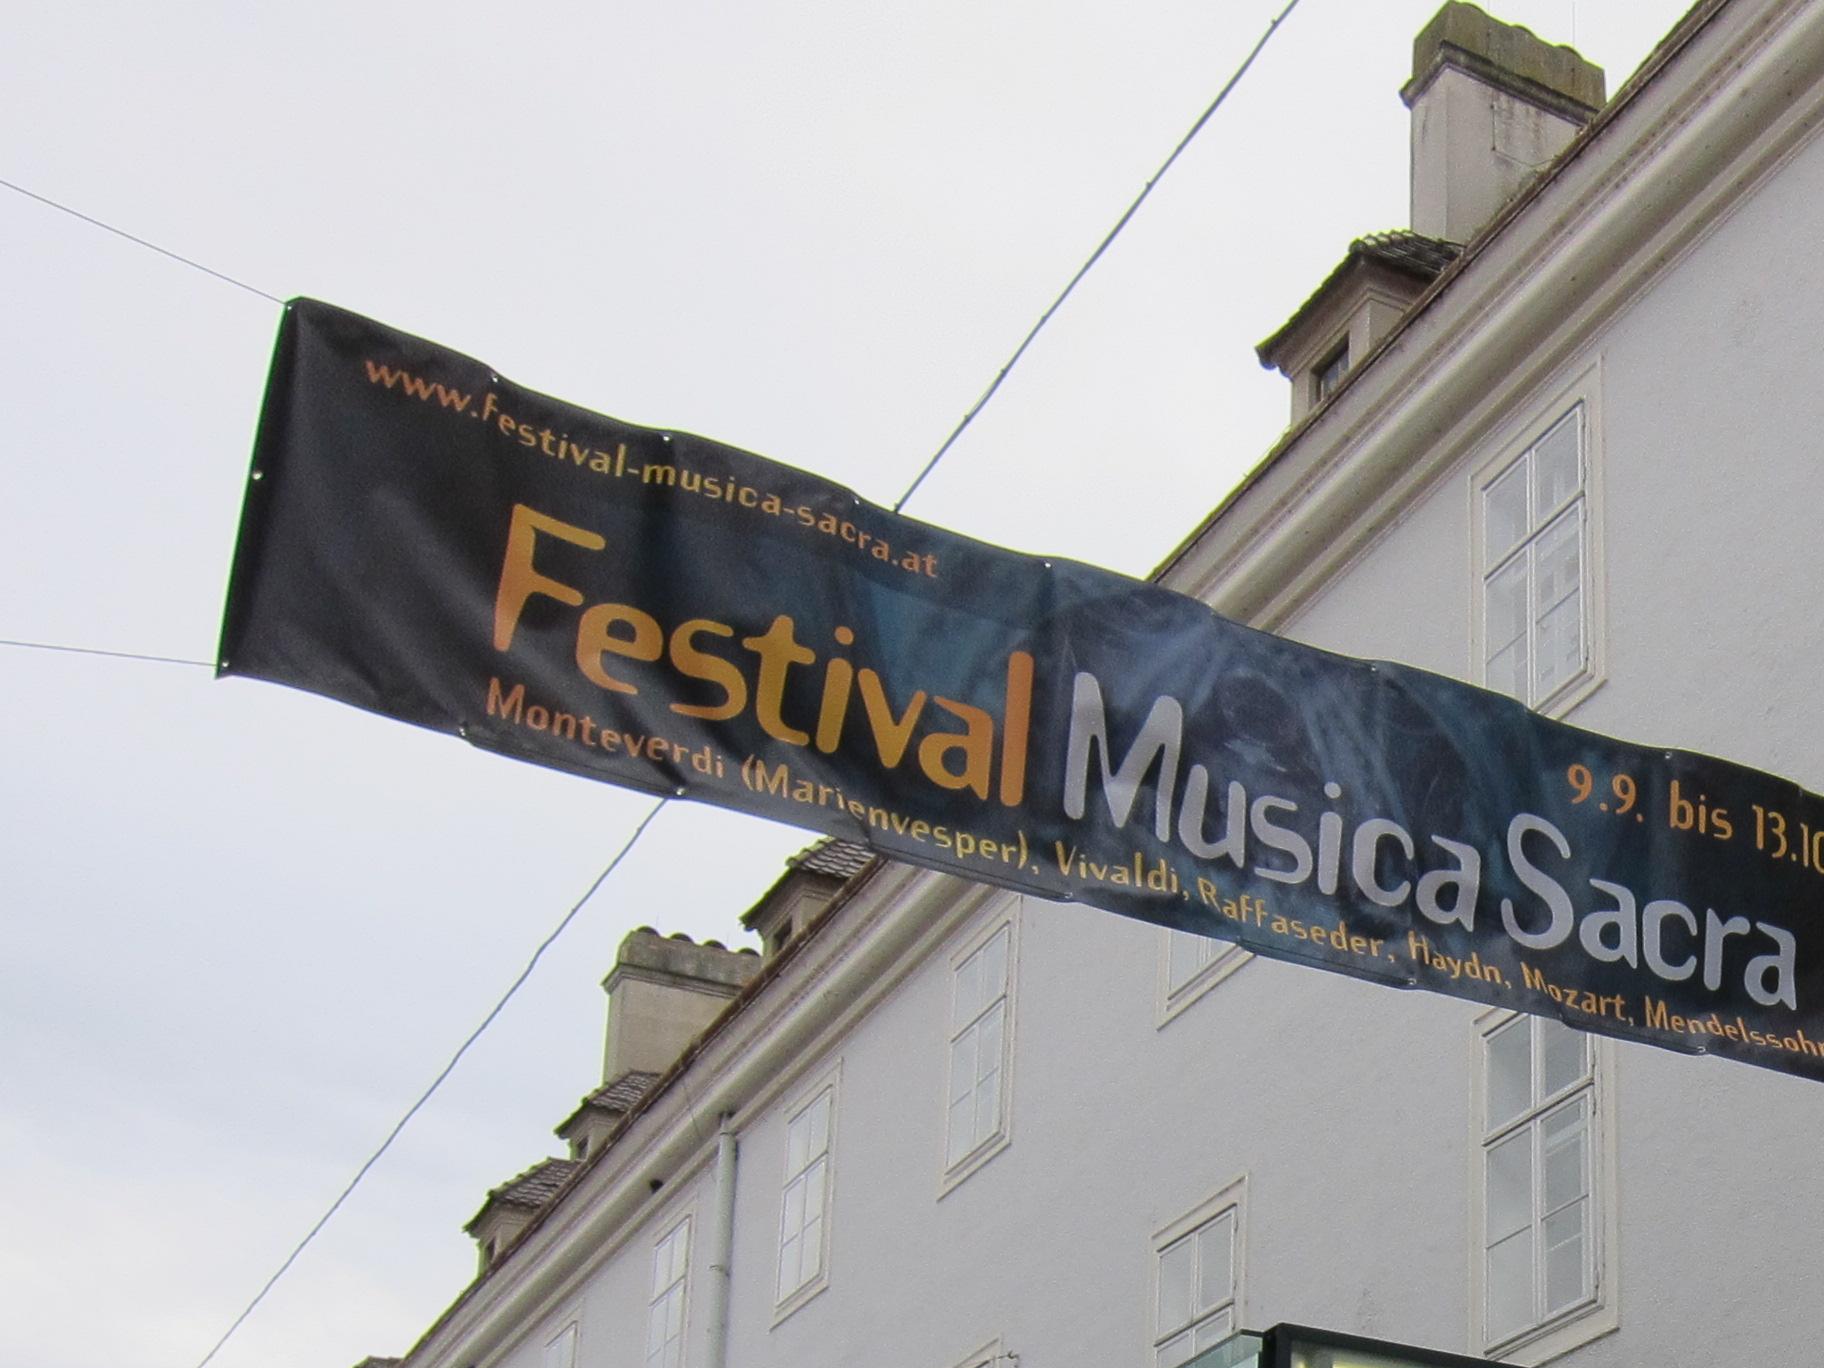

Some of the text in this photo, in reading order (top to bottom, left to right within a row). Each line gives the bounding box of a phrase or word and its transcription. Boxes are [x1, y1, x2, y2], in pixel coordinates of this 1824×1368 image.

[364, 360, 937, 577] www.festival-musica-sacra.at
[494, 504, 1034, 806] Festival
[487, 677, 724, 778] Monteverdi
[743, 754, 1040, 874] (Marienvesper),
[1055, 840, 1189, 900] Vivaldi,
[1198, 878, 1395, 963] Raffaseder,
[1408, 931, 1512, 989] Haydn,
[1520, 962, 1634, 1026] Mozart,
[1567, 764, 1643, 823] 9.9.
[1669, 779, 1733, 841] bis
